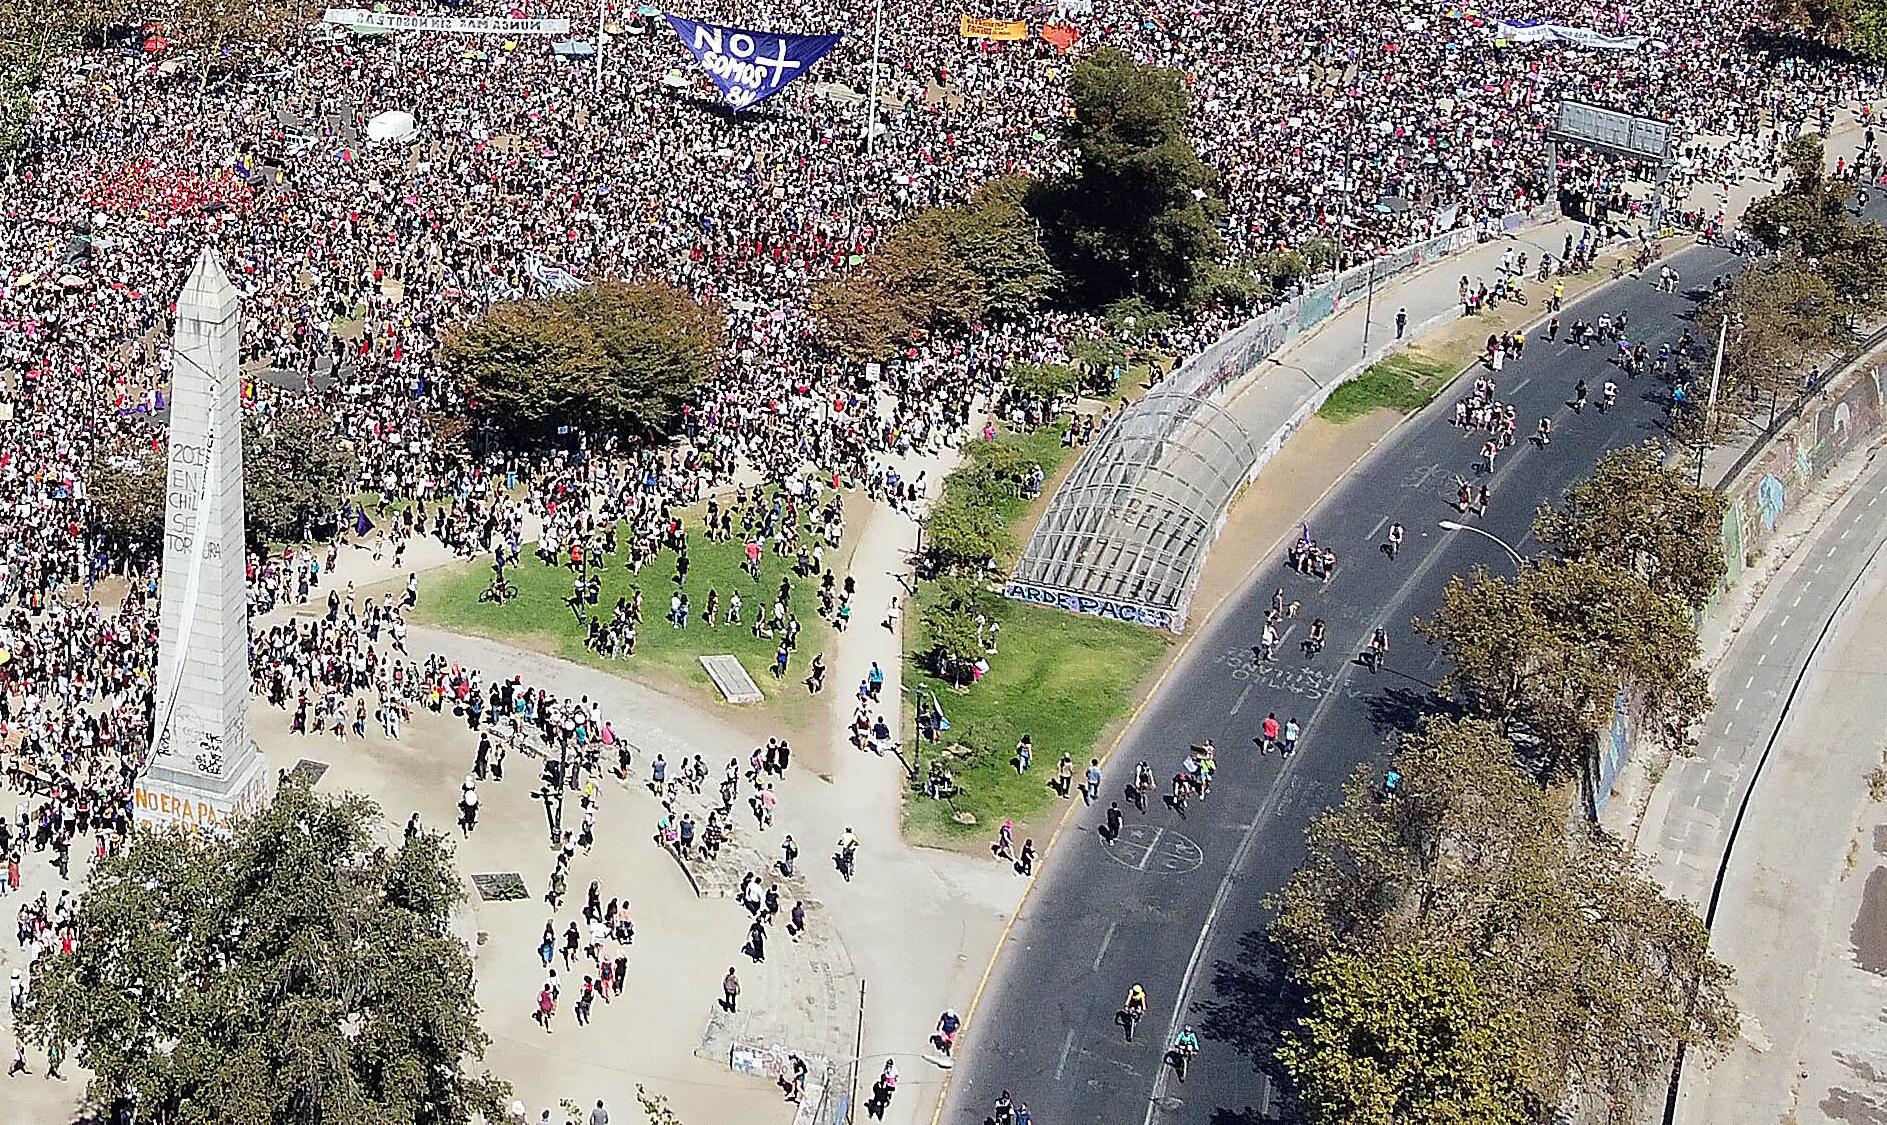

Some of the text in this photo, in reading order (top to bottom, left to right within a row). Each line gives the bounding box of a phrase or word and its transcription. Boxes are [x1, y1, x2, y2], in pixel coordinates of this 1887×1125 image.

[694, 25, 755, 58] NO
[702, 50, 767, 89] SOMOS
[173, 469, 197, 493] EN
[173, 513, 197, 535] SE
[1010, 585, 1070, 610] ARDE
[135, 787, 159, 812] NO
[161, 793, 194, 822] ERA
